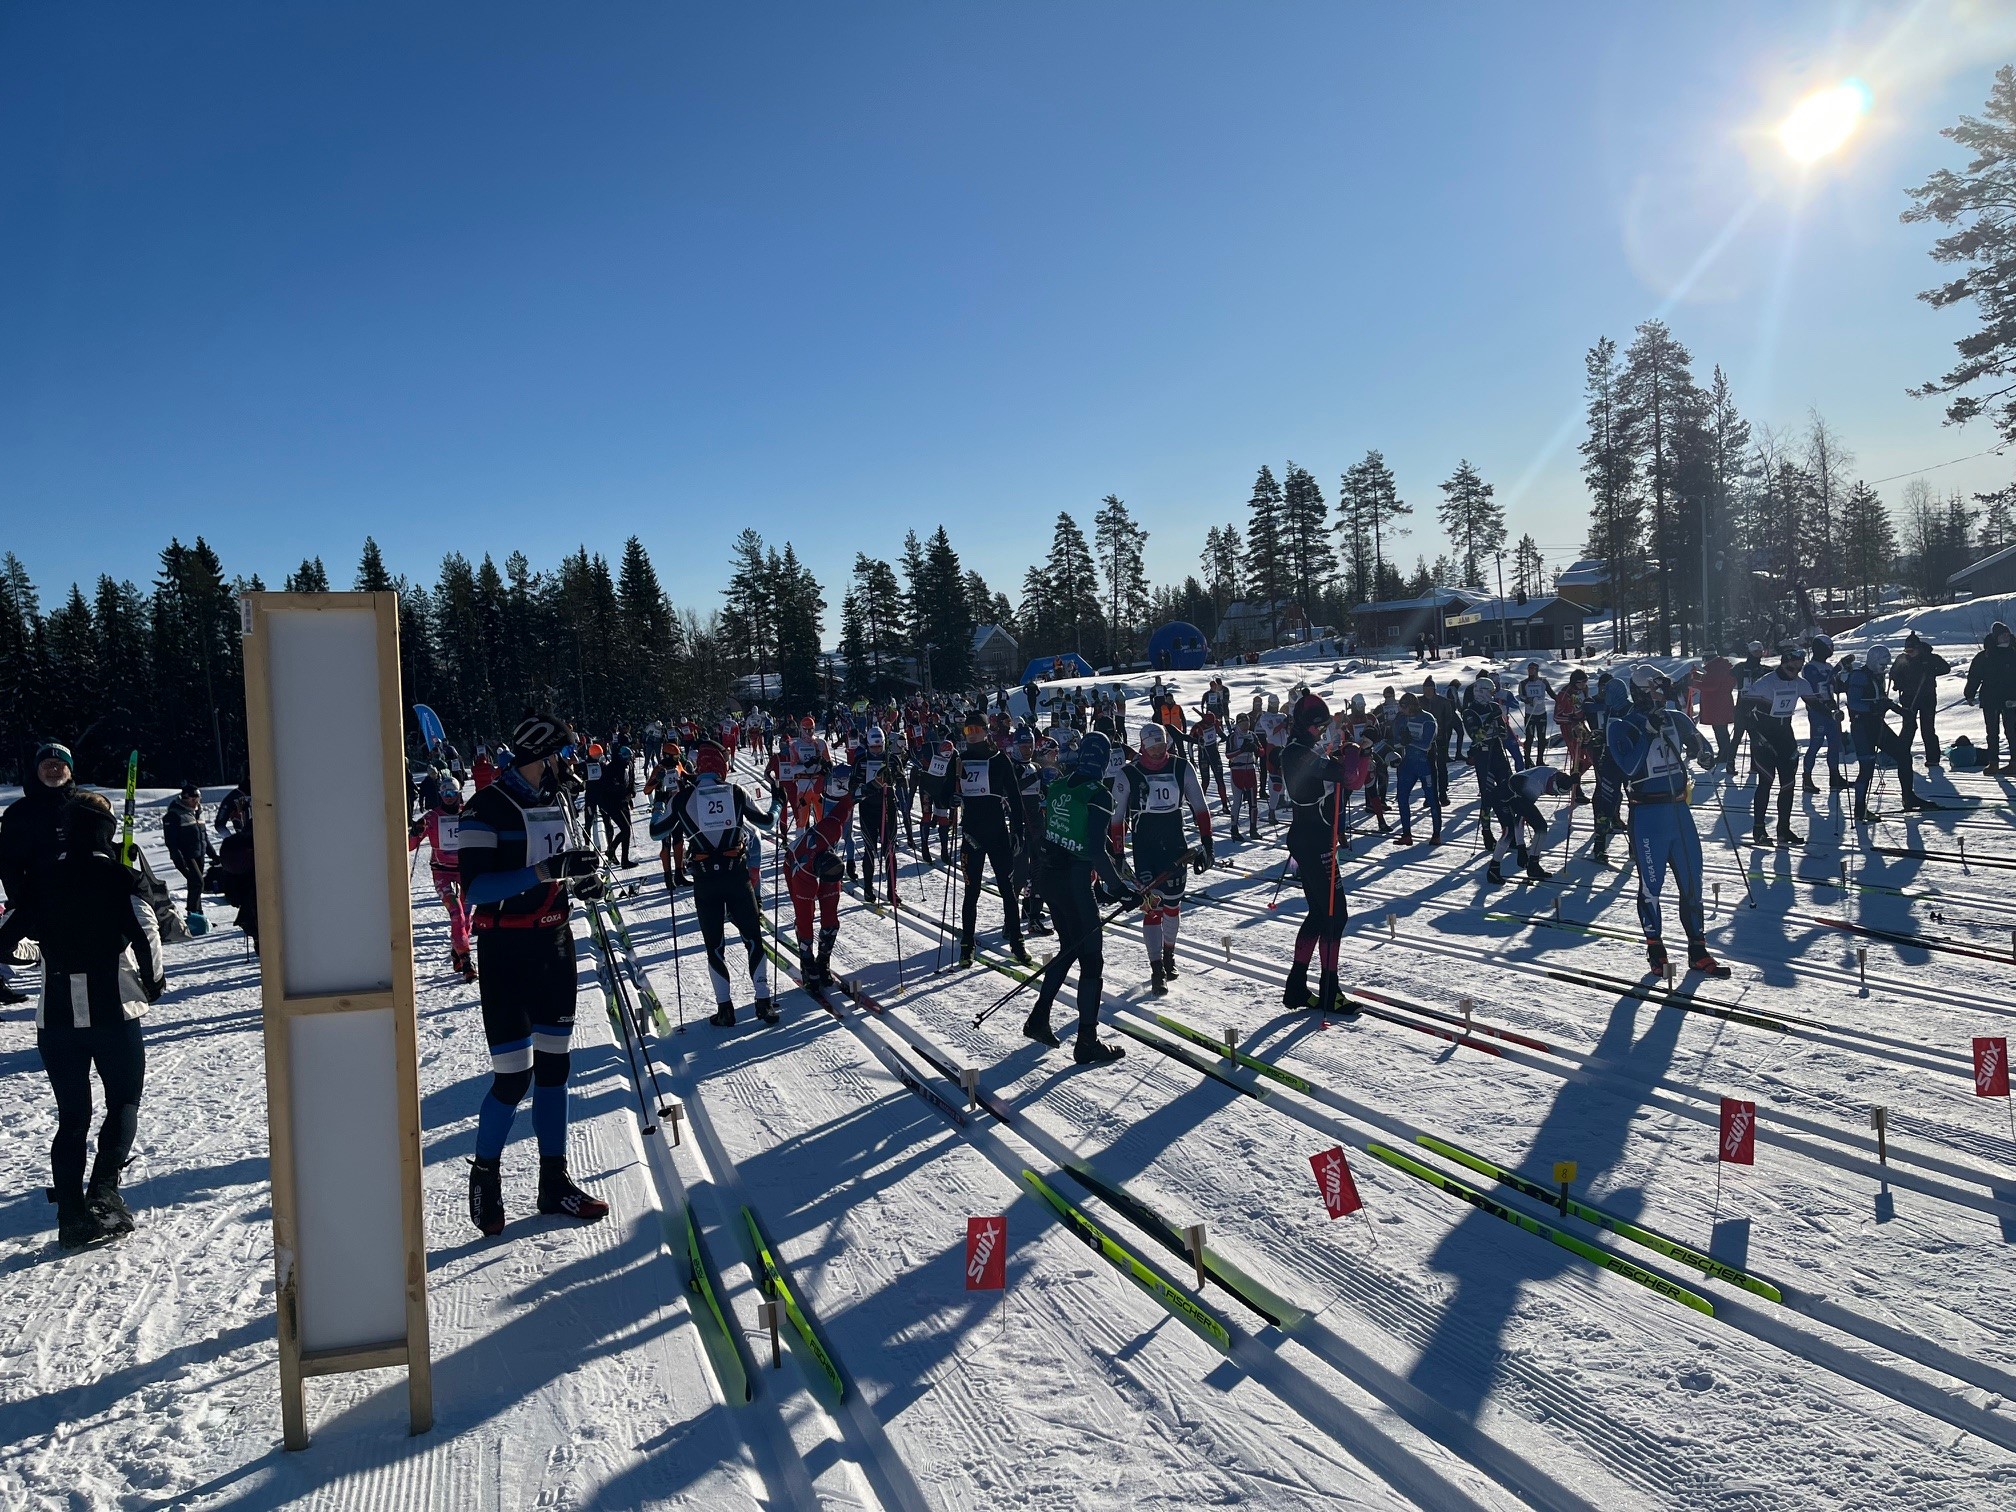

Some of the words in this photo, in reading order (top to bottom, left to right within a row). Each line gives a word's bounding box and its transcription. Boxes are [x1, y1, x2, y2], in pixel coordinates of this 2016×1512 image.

[1780, 700, 1790, 708] 57
[933, 762, 944, 771] 119
[1110, 757, 1122, 766] 123
[967, 771, 979, 783] 27
[1155, 788, 1169, 800] 10
[708, 801, 724, 814] 25
[544, 832, 566, 854] 12
[1643, 837, 1653, 864] SKILAG
[1648, 865, 1657, 883] SVEA
[541, 914, 562, 924] COXA
[1266, 1066, 1298, 1085] FISCHER
[1561, 1168, 1568, 1179] 8
[474, 1184, 482, 1226] alpina
[1669, 1248, 1747, 1286] FISCHER
[1606, 1259, 1681, 1300] FISCHER
[1165, 1289, 1213, 1328] FISCHER
[809, 1338, 836, 1381] FISCHER
